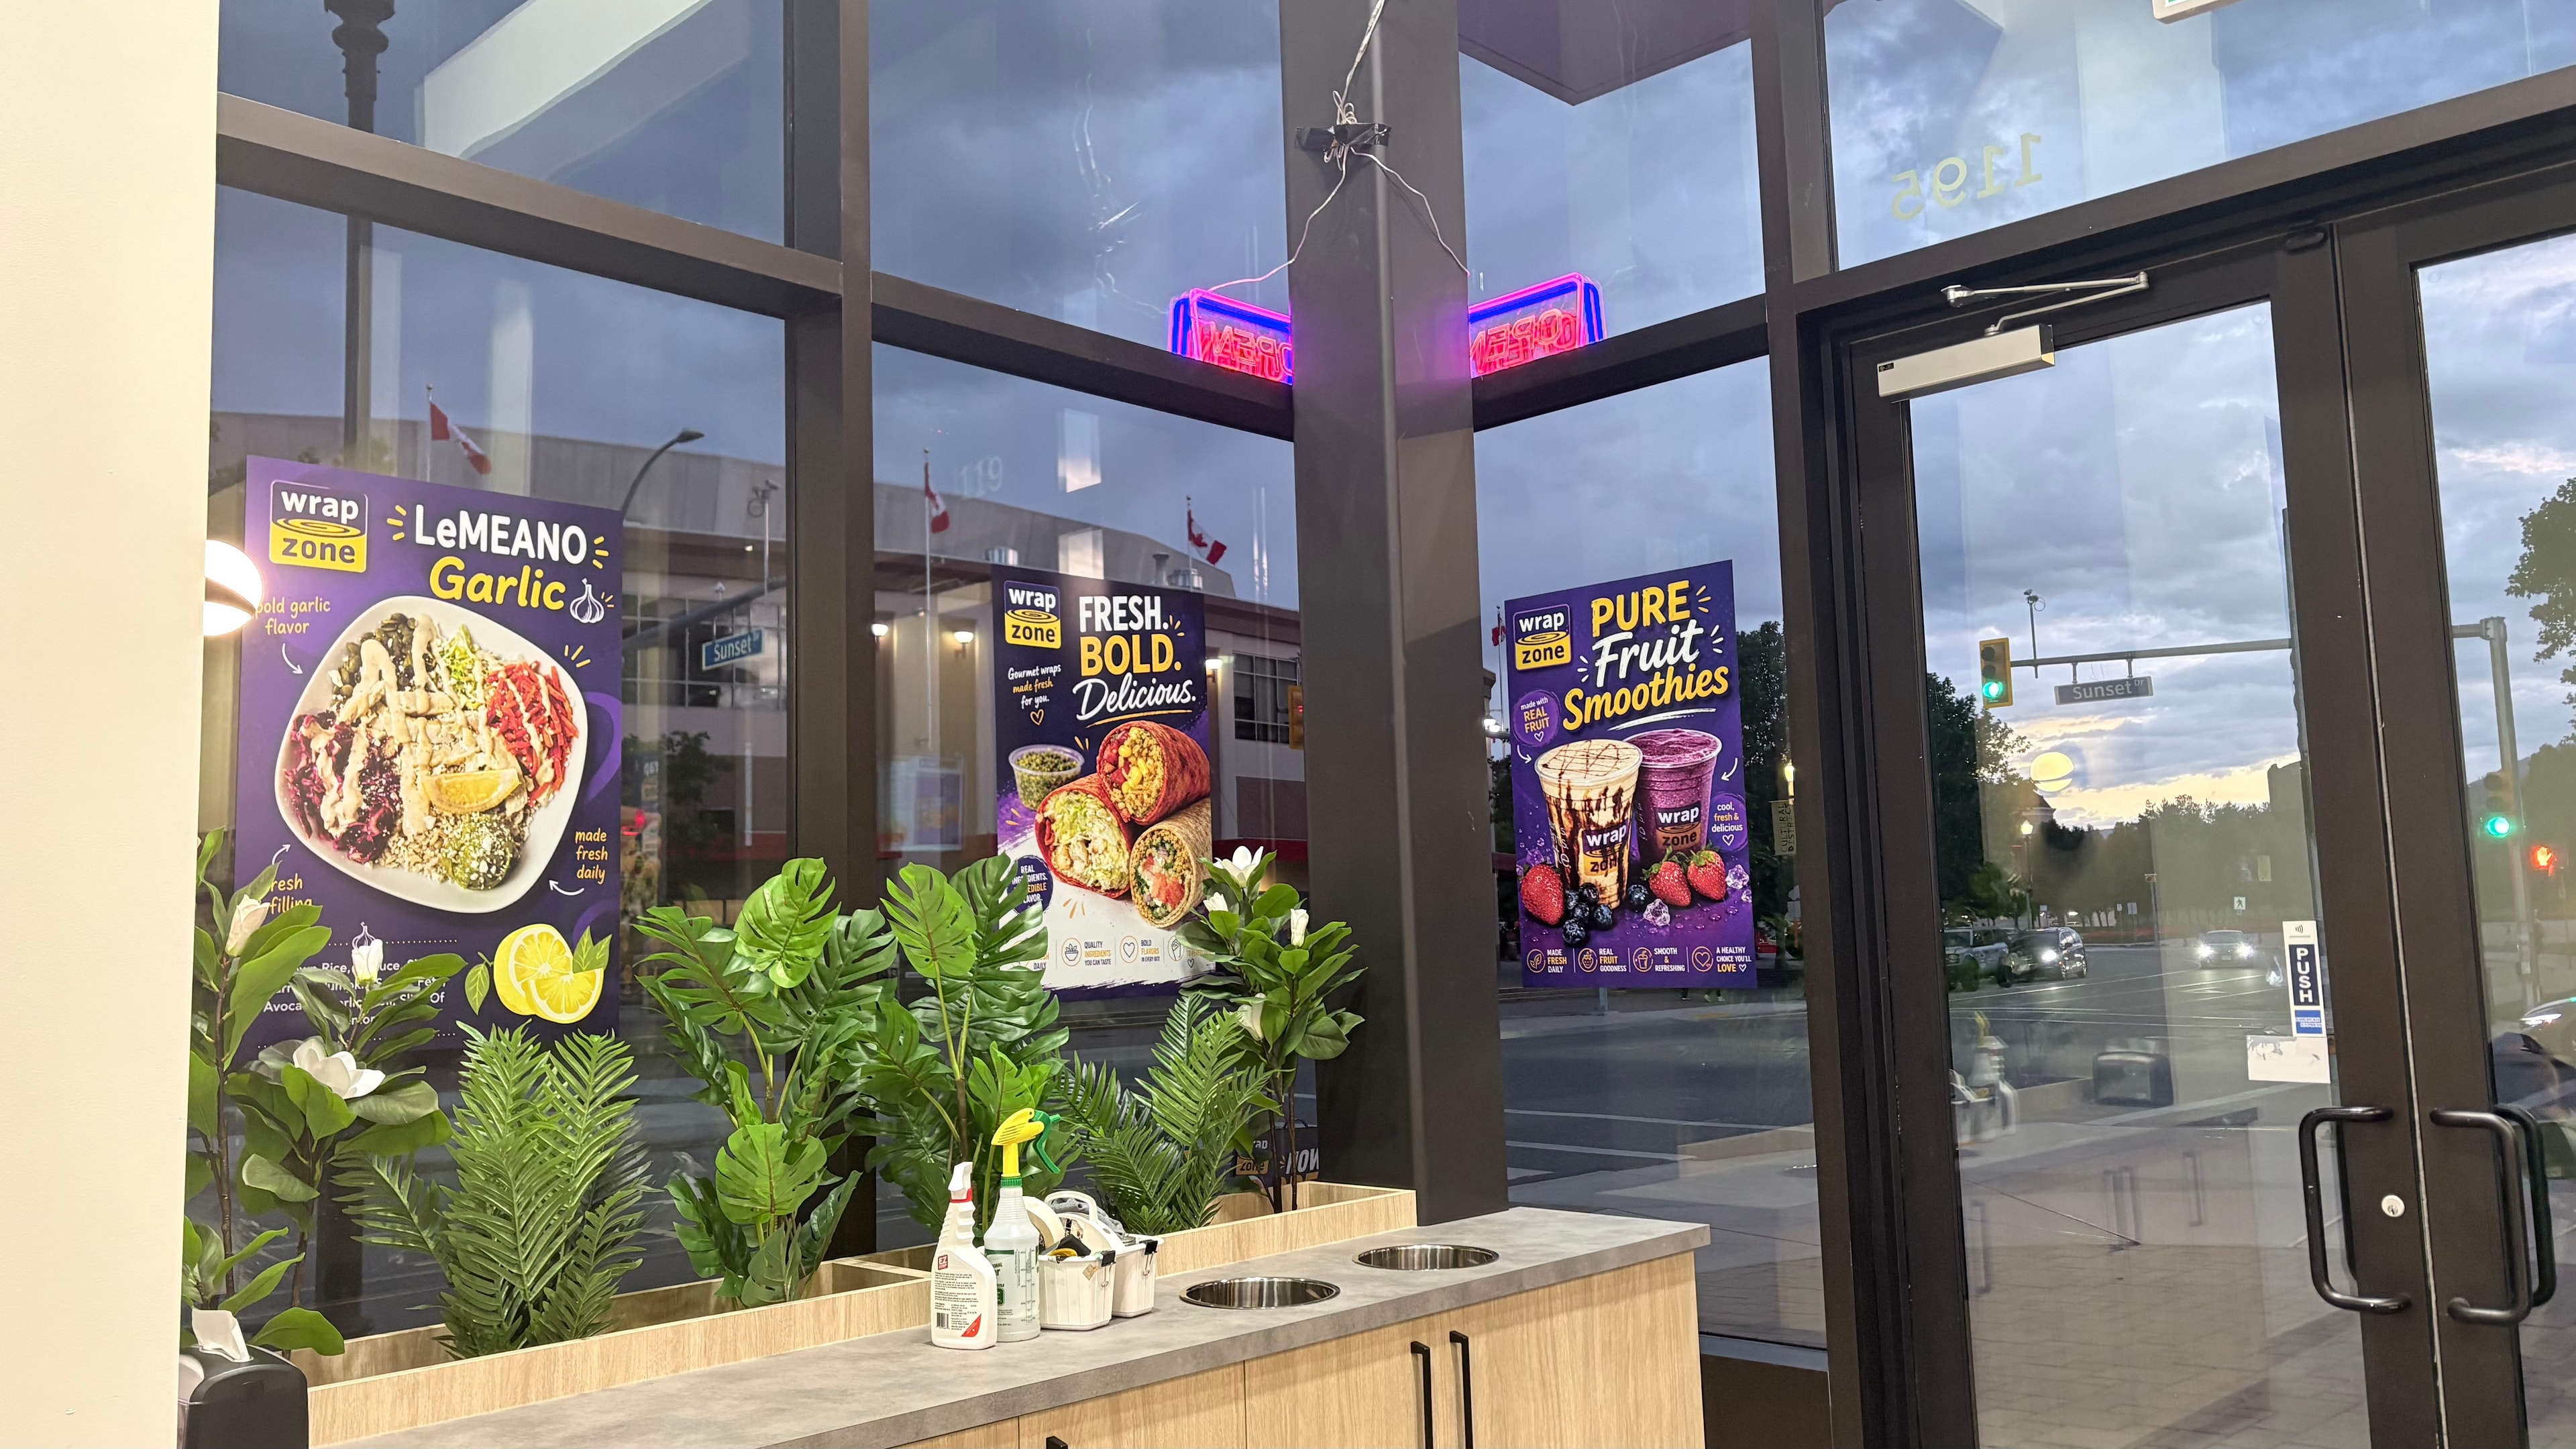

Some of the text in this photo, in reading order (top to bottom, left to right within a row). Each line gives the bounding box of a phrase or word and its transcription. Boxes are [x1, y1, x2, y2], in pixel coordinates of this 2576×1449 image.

[281, 490, 359, 524] wrap
[415, 504, 587, 565] LeMEANO
[282, 537, 356, 564] zone
[429, 556, 566, 610] Garlic
[290, 596, 331, 619] garlic
[1008, 588, 1056, 612] wrap
[1591, 580, 1690, 637] PURE
[1079, 595, 1169, 633] FRESH.
[1519, 611, 1564, 633] wrap
[265, 618, 309, 635] flavor
[1012, 624, 1056, 643] zone
[714, 635, 751, 662] Sunset
[1080, 633, 1181, 676] BOLD.
[1522, 644, 1564, 664] zone
[1592, 619, 1704, 688] Fruit
[1008, 664, 1061, 680] Gourmet wraps
[1013, 676, 1053, 693] made fresh
[2073, 681, 2133, 699] Sunset
[1021, 695, 1049, 709] for you.
[1073, 672, 1196, 721] Delicious.
[1521, 696, 1548, 710] made with
[1562, 663, 1729, 731] Smoothies
[1523, 706, 1548, 722] REAL
[1524, 716, 1549, 733] FRUIT
[1658, 806, 1699, 823] wrap
[1717, 802, 1735, 811] cool,
[1714, 812, 1739, 822] fresh &
[575, 828, 607, 844] made
[1586, 824, 1626, 847] wrap
[1711, 823, 1743, 833] delicious
[1662, 831, 1697, 846] zone
[576, 845, 608, 861] fresh
[576, 864, 606, 885] daily
[1020, 865, 1035, 873] REAL
[270, 873, 303, 892] resh
[1599, 956, 1618, 964] FRUIT
[1654, 947, 1677, 955] SMOOTH
[1548, 957, 1567, 965] FRESH
[1717, 963, 1737, 972] LOVE
[2296, 947, 2313, 1003] PUSH
[430, 991, 445, 1004] Of
